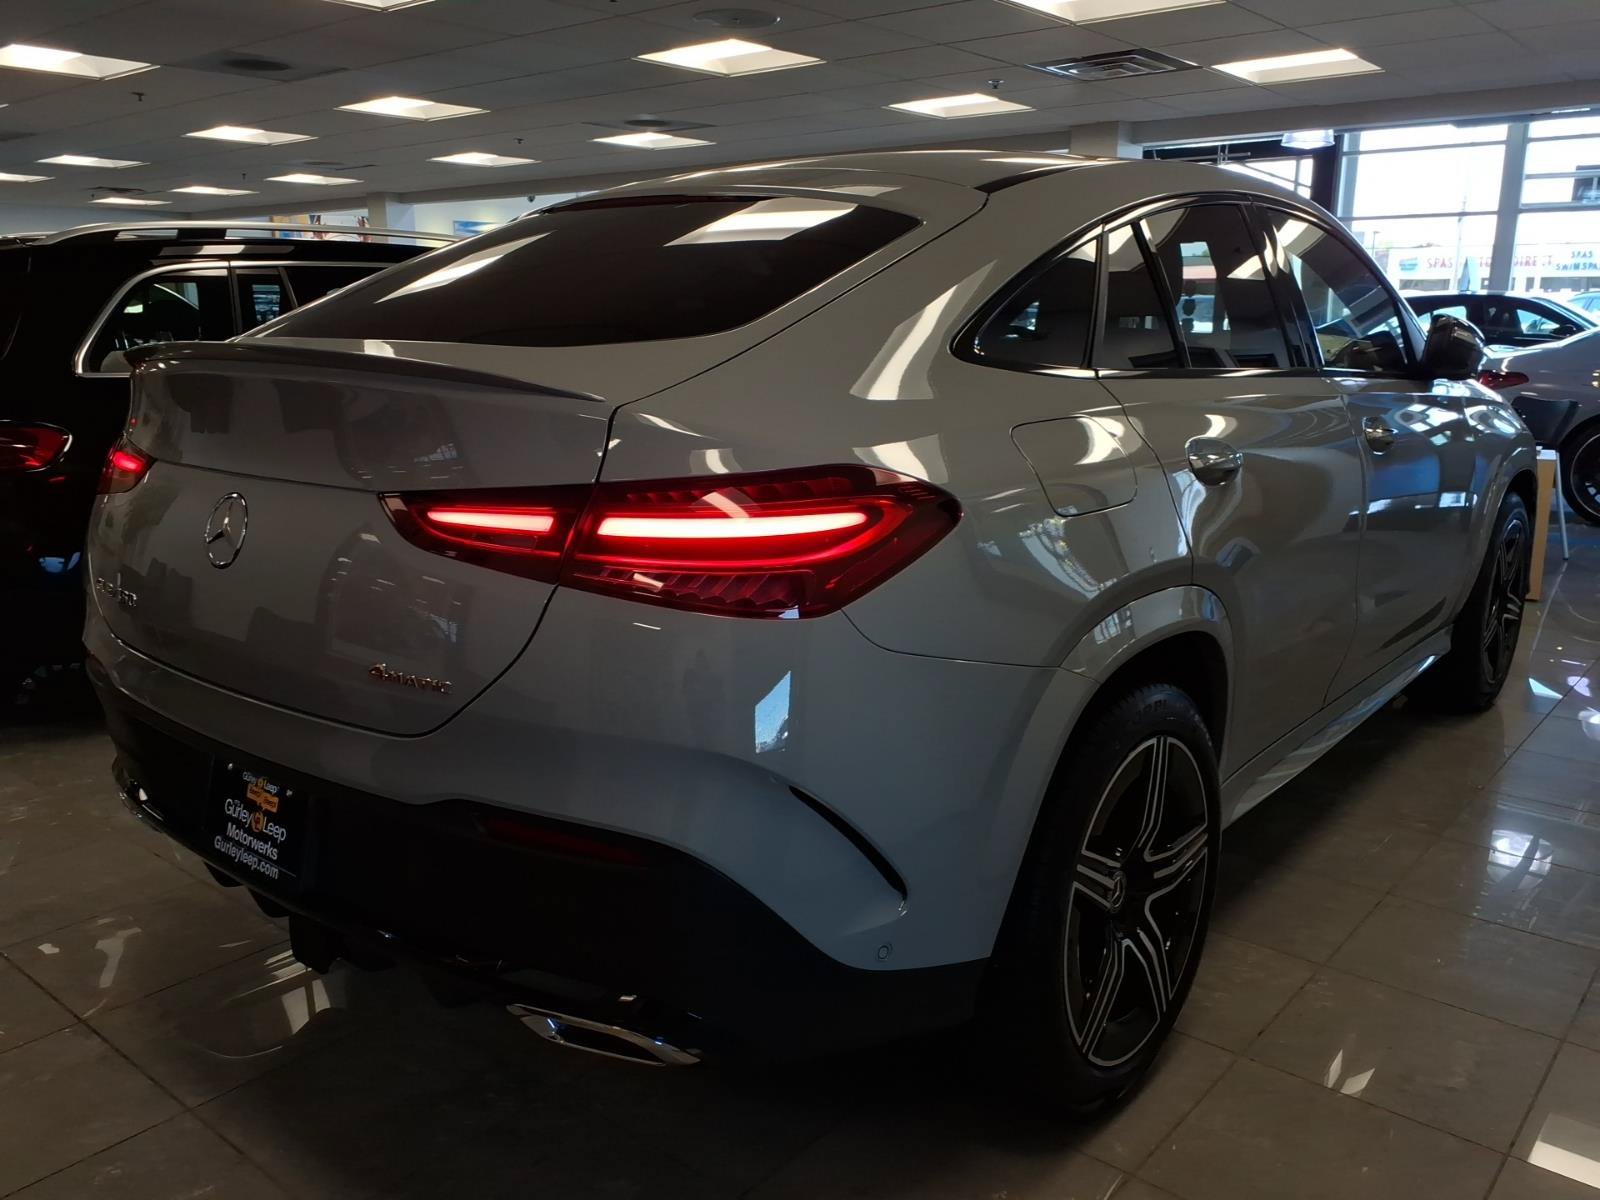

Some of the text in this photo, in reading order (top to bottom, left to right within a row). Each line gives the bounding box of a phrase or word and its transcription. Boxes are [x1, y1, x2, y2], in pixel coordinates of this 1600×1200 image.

[1426, 256, 1453, 269] SPAS
[1581, 261, 1600, 271] SPA
[226, 821, 278, 860] Motorwerks
[262, 816, 287, 844] Leep
[214, 835, 279, 879] Gurleyleep.com
